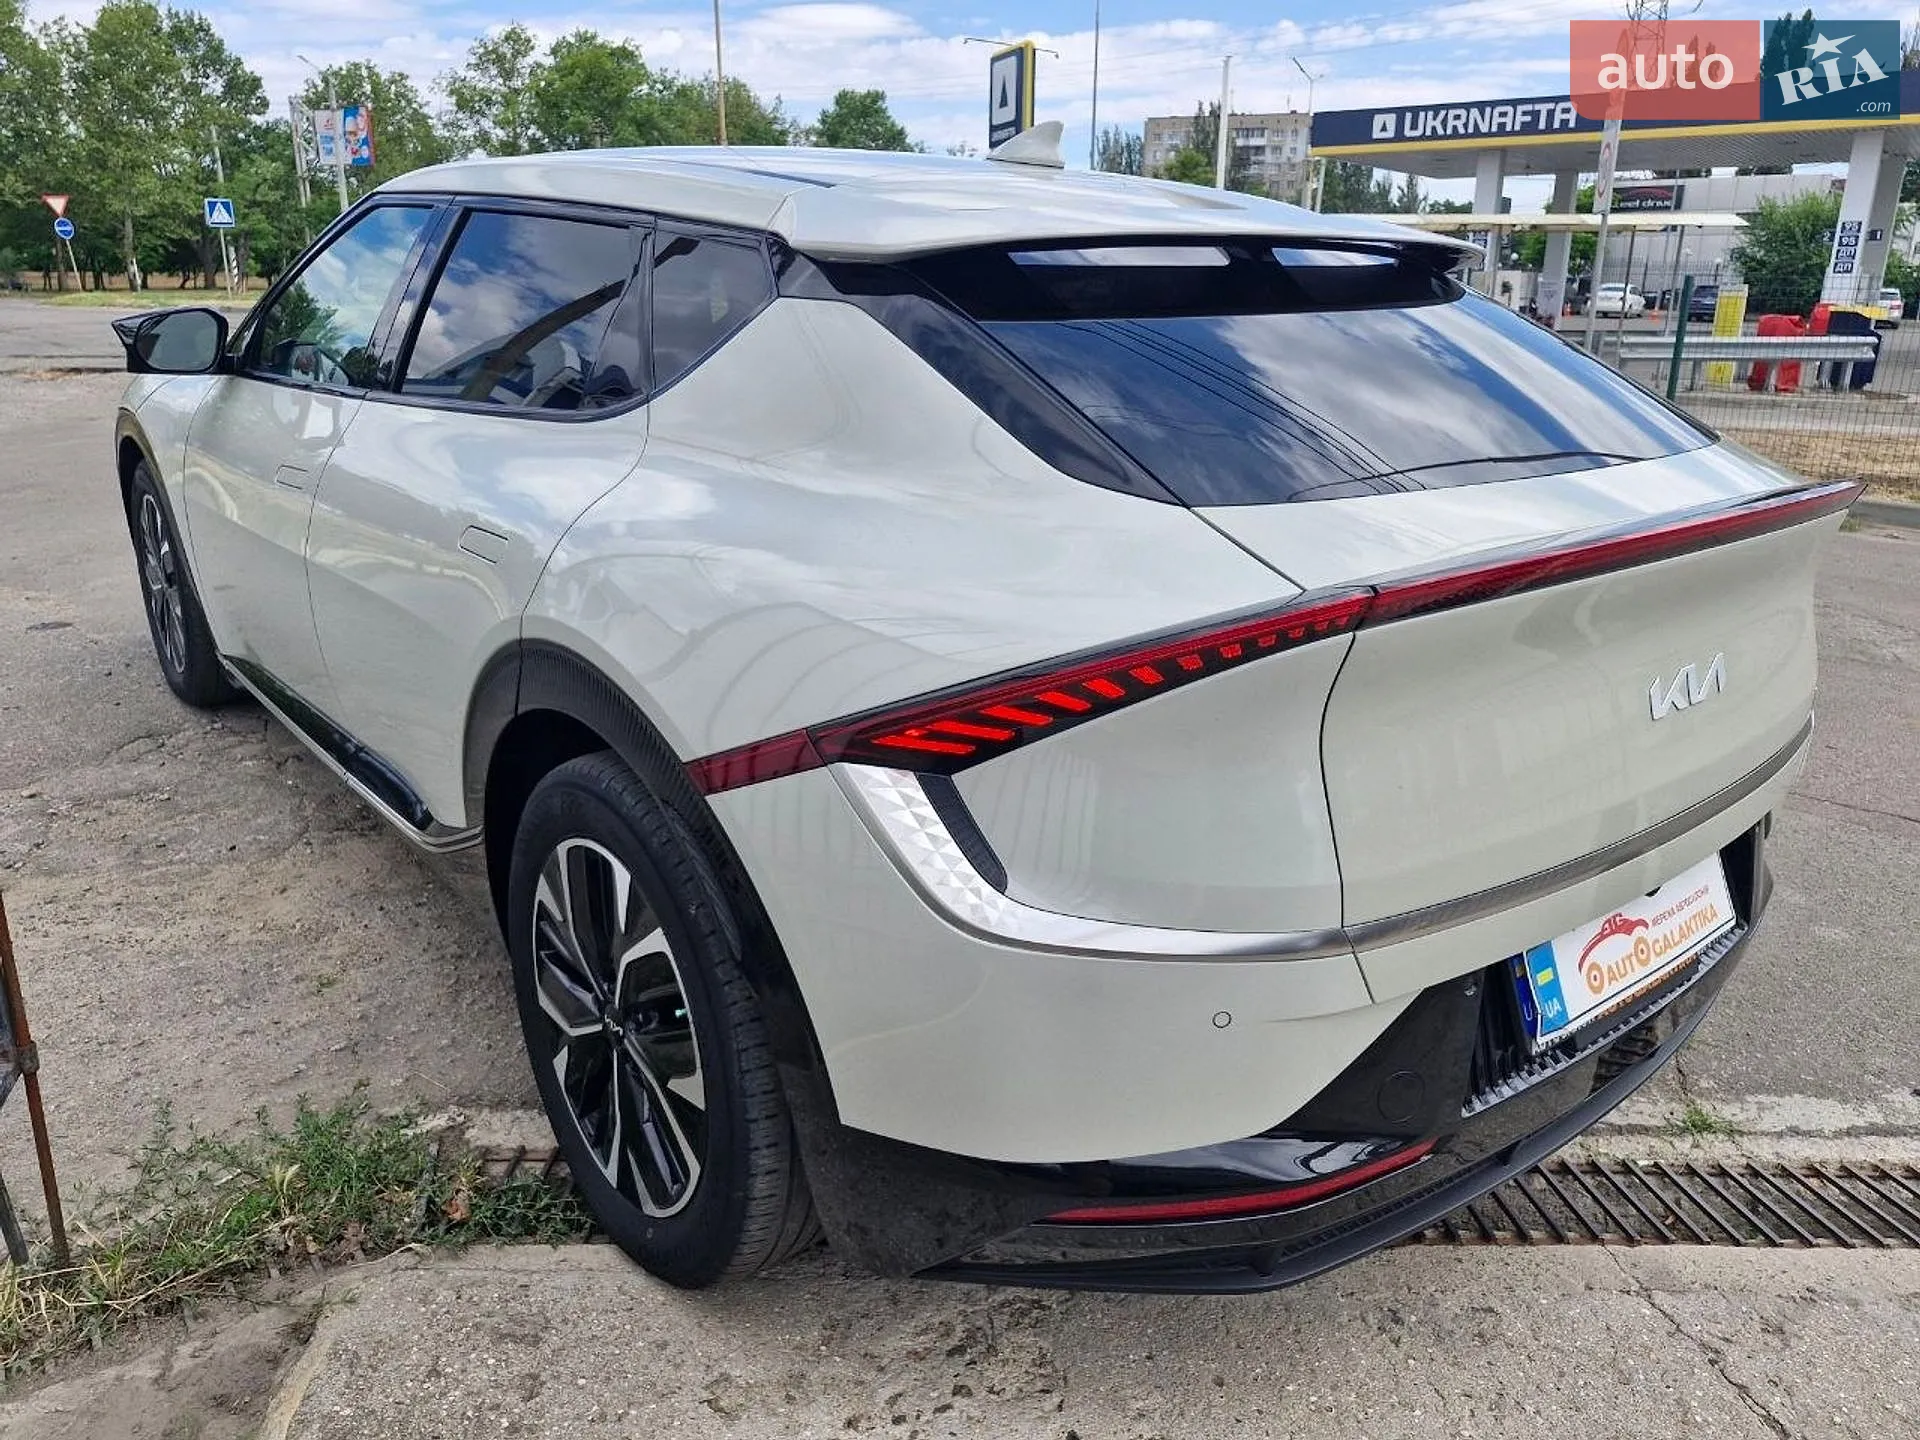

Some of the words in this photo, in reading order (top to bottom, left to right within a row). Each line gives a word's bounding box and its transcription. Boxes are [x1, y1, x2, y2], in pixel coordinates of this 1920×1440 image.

[1403, 101, 1578, 138] UKRNAFTA
[1841, 236, 1856, 246] 95
[1544, 997, 1563, 1018] UA
